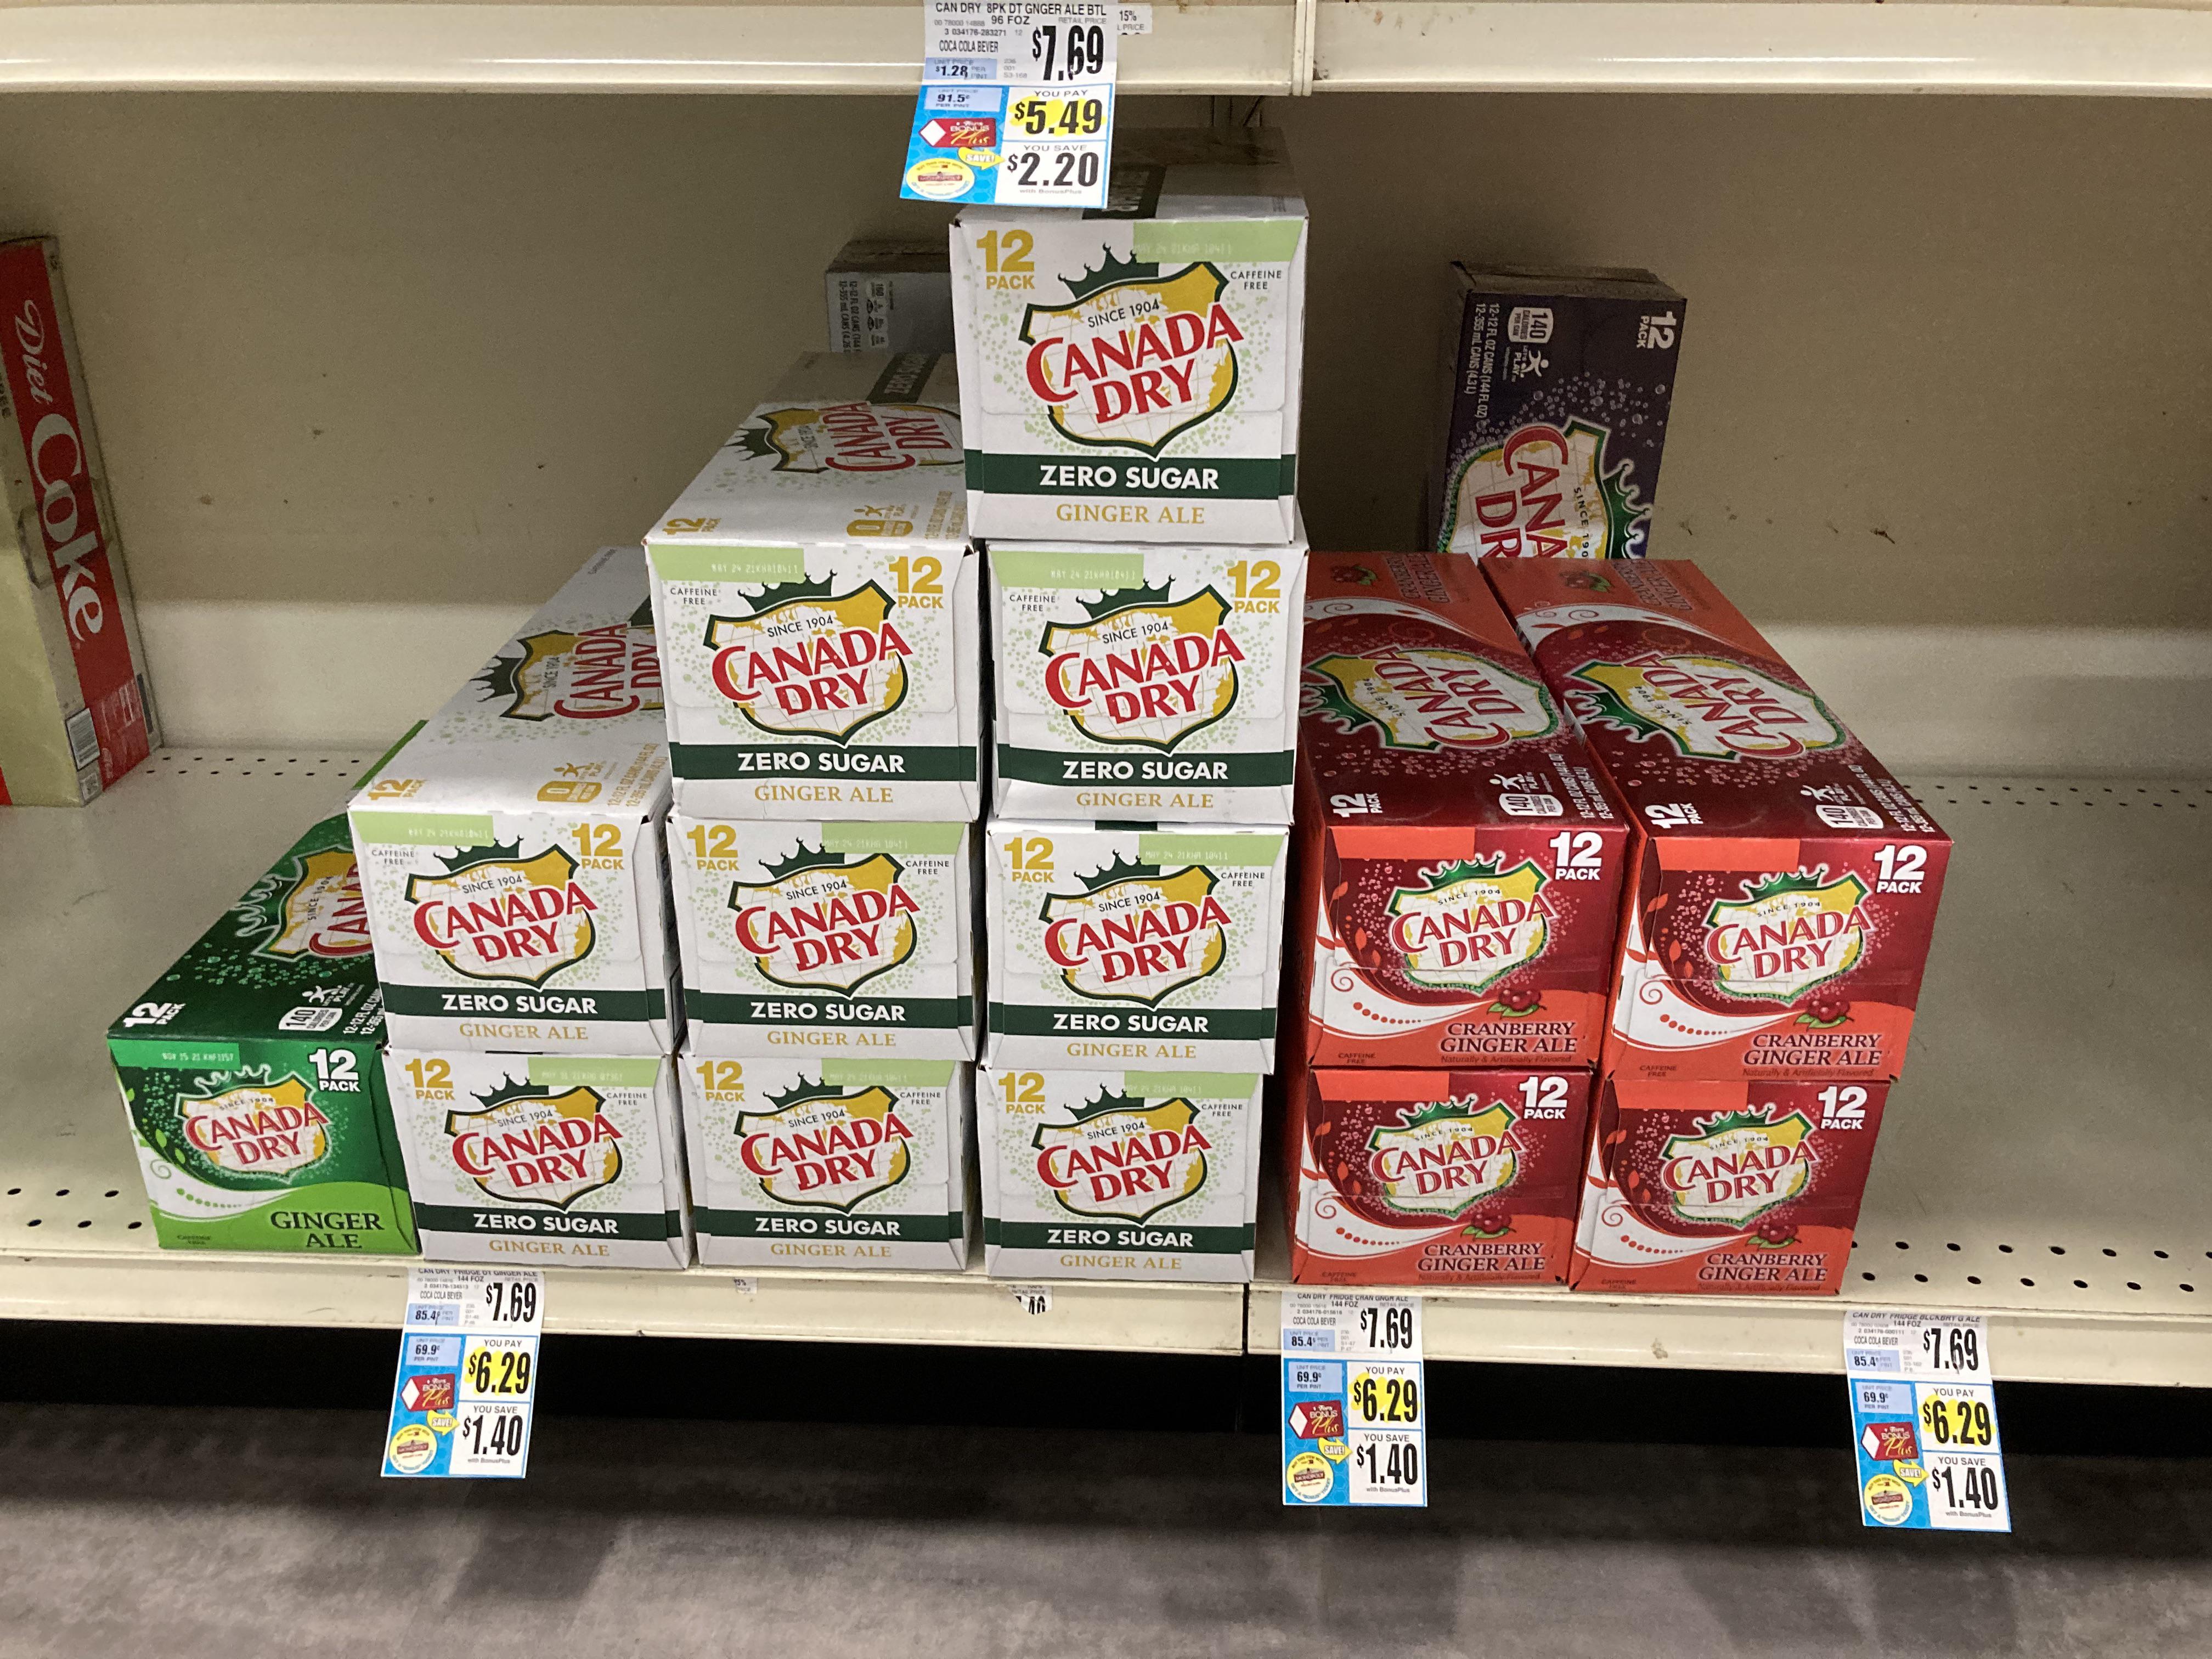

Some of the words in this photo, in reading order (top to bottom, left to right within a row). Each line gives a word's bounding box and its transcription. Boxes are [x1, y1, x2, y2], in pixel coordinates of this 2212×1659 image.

[936, 4, 958, 13] CAN
[961, 3, 980, 13] DRY
[987, 4, 1006, 14] 8PK
[1009, 4, 1022, 14] DT
[1025, 5, 1061, 15] GNGER
[1065, 5, 1084, 15] ALE
[1087, 5, 1106, 15] BTL
[991, 16, 1003, 25] 96
[1008, 16, 1030, 25] FOZ
[1119, 10, 1137, 21] 15%
[939, 40, 956, 52] COCA
[958, 40, 976, 52] COLA
[978, 41, 998, 52] BEVER
[1032, 25, 1104, 81] $7.69
[1014, 99, 1103, 134] $5.49
[1007, 152, 1099, 187] $2.20
[977, 229, 1035, 272] 12
[986, 275, 1035, 290] PACK
[1230, 270, 1281, 280] CAFFEINE
[1244, 281, 1268, 290] FREE
[1087, 309, 1125, 328] SINCE
[1129, 300, 1160, 317] 1904
[1529, 312, 1547, 340] 140
[1647, 311, 1677, 349] 12
[1636, 315, 1646, 348] PACK
[14, 298, 53, 405] Diet
[1025, 304, 1243, 402] CANADA
[1092, 359, 1194, 424] DRY
[1040, 465, 1116, 487] ZERO
[1126, 467, 1218, 490] SUGAR
[31, 413, 104, 642] Coke
[1056, 504, 1149, 523] GINGER
[1159, 506, 1205, 524] ALE
[889, 556, 943, 594] 12
[1228, 560, 1280, 598] 12
[898, 596, 944, 608] PACK
[1234, 601, 1279, 613] PACK
[768, 623, 803, 637] SINCE
[806, 616, 833, 629] 1904
[712, 623, 913, 701] CANADA
[1045, 628, 1245, 708] CANADA
[775, 669, 868, 715] DRY
[1105, 676, 1199, 724] DRY
[738, 752, 810, 771] ZERO
[819, 754, 906, 773] SUGAR
[1063, 761, 1133, 779] ZERO
[1142, 761, 1228, 780] SUGAR
[755, 785, 843, 802] GINGER
[850, 787, 893, 803] ALE
[572, 823, 622, 856] 12
[687, 825, 738, 857] 12
[1550, 831, 1602, 867] 12
[582, 858, 624, 870] PACK
[697, 860, 740, 871] PACK
[1556, 868, 1600, 880] PACK
[1875, 845, 1927, 881] 12
[1877, 882, 1921, 893] PACK
[414, 882, 598, 949] CANADA
[736, 884, 920, 954] CANADA
[1045, 896, 1231, 967] CANADA
[1392, 894, 1554, 953] CANADA
[474, 922, 560, 962] DRY
[792, 924, 879, 972] DRY
[1440, 929, 1516, 968] DRY
[1707, 907, 1872, 964] CANADA
[1102, 936, 1189, 983] DRY
[1754, 940, 1833, 979] DRY
[442, 994, 508, 1012] ZERO
[517, 997, 598, 1014] SUGAR
[751, 1002, 817, 1019] ZERO
[826, 1003, 906, 1021] SUGAR
[1053, 1014, 1120, 1031] ZERO
[1128, 1015, 1208, 1033] SUGAR
[1448, 1023, 1575, 1035] CRANBERRY
[1067, 1043, 1148, 1057] GINGER
[1155, 1045, 1197, 1058] ALE
[1440, 1037, 1530, 1052] GINGER
[1535, 1037, 1576, 1053] ALE
[1744, 1049, 1835, 1065] GINGER
[1836, 1050, 1882, 1065] ALE
[1753, 1034, 1881, 1047] CRANBERRY
[308, 1049, 359, 1080] 12
[319, 1080, 359, 1092] PACK
[184, 1101, 329, 1152] CANADA
[235, 1135, 303, 1165] DRY
[452, 1114, 623, 1175] CANADA
[741, 1113, 914, 1176] CANADA
[1037, 1125, 1212, 1188] CANADA
[1372, 1131, 1522, 1183] CANADA
[506, 1150, 586, 1188] DRY
[794, 1149, 875, 1191] DRY
[1090, 1161, 1172, 1202] DRY
[1417, 1161, 1487, 1195] DRY
[1663, 1141, 1818, 1192] CANADA
[1708, 1171, 1780, 1204] DRY
[270, 1210, 384, 1231] GINGER
[474, 1214, 536, 1230] ZERO
[544, 1216, 619, 1234] SUGAR
[755, 1217, 817, 1233] ZERO
[825, 1220, 900, 1235] SUGAR
[304, 1233, 363, 1249] ALE
[1048, 1229, 1110, 1245] ZERO
[1118, 1231, 1193, 1247] SUGAR
[1424, 1243, 1544, 1256] CRANBERRY
[1418, 1257, 1500, 1271] GINGER
[1504, 1257, 1544, 1270] ALE
[420, 1291, 432, 1299] COCA
[433, 1291, 446, 1299] COLA
[447, 1291, 462, 1300] BEVER
[486, 1282, 536, 1322] $7.69
[1361, 1308, 1412, 1348] $7.69
[1923, 1328, 1978, 1370] $7.69
[469, 1352, 531, 1393] $6.29
[1354, 1379, 1418, 1422] $6.29
[463, 1415, 523, 1456] $1.40
[1923, 1400, 1991, 1445] $6.29
[1324, 1446, 1344, 1454] SAVE!
[1357, 1443, 1418, 1485] $1.40
[1961, 1458, 1986, 1466] SAVE
[1932, 1466, 1998, 1510] $1.40
